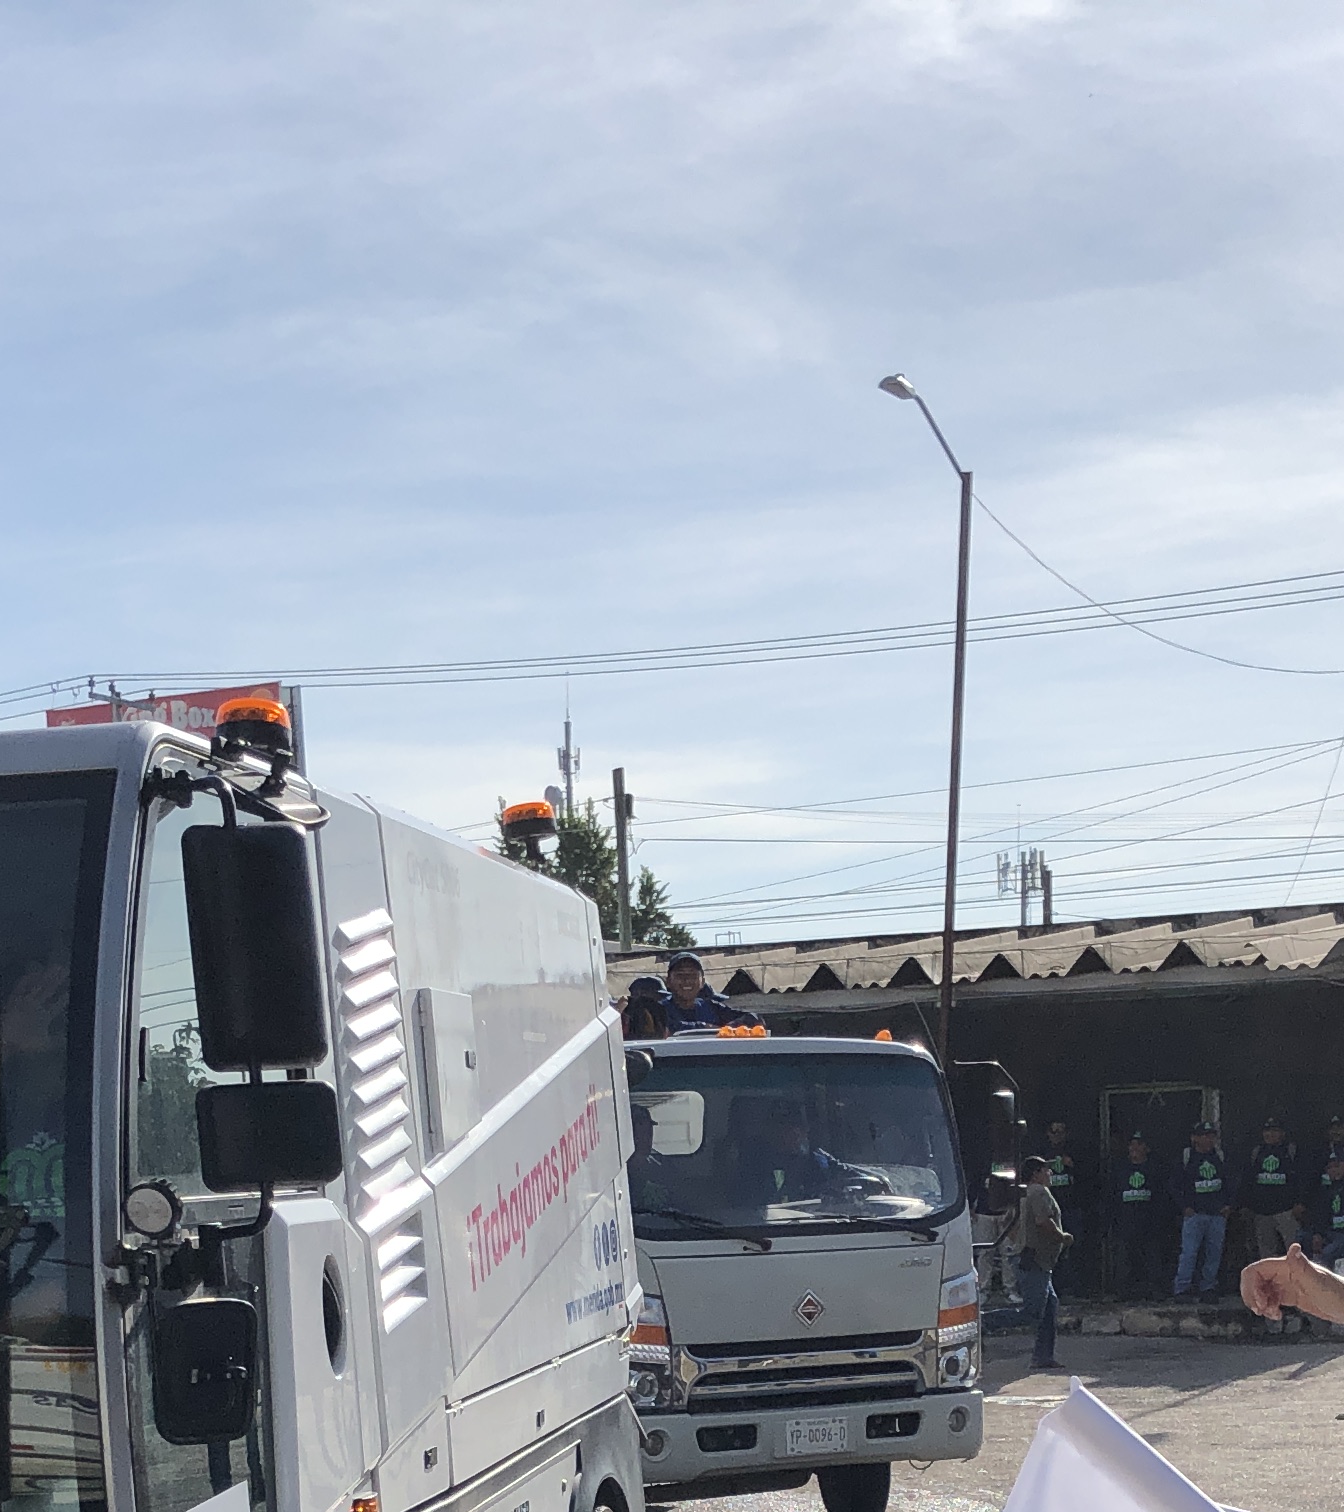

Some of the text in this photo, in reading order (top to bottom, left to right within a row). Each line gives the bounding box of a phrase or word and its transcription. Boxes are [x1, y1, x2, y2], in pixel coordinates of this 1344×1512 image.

[170, 700, 216, 731] Box
[467, 1146, 560, 1292] ¡Trabajamos
[560, 1111, 588, 1204] para
[790, 1426, 846, 1445] YP-0096-D
